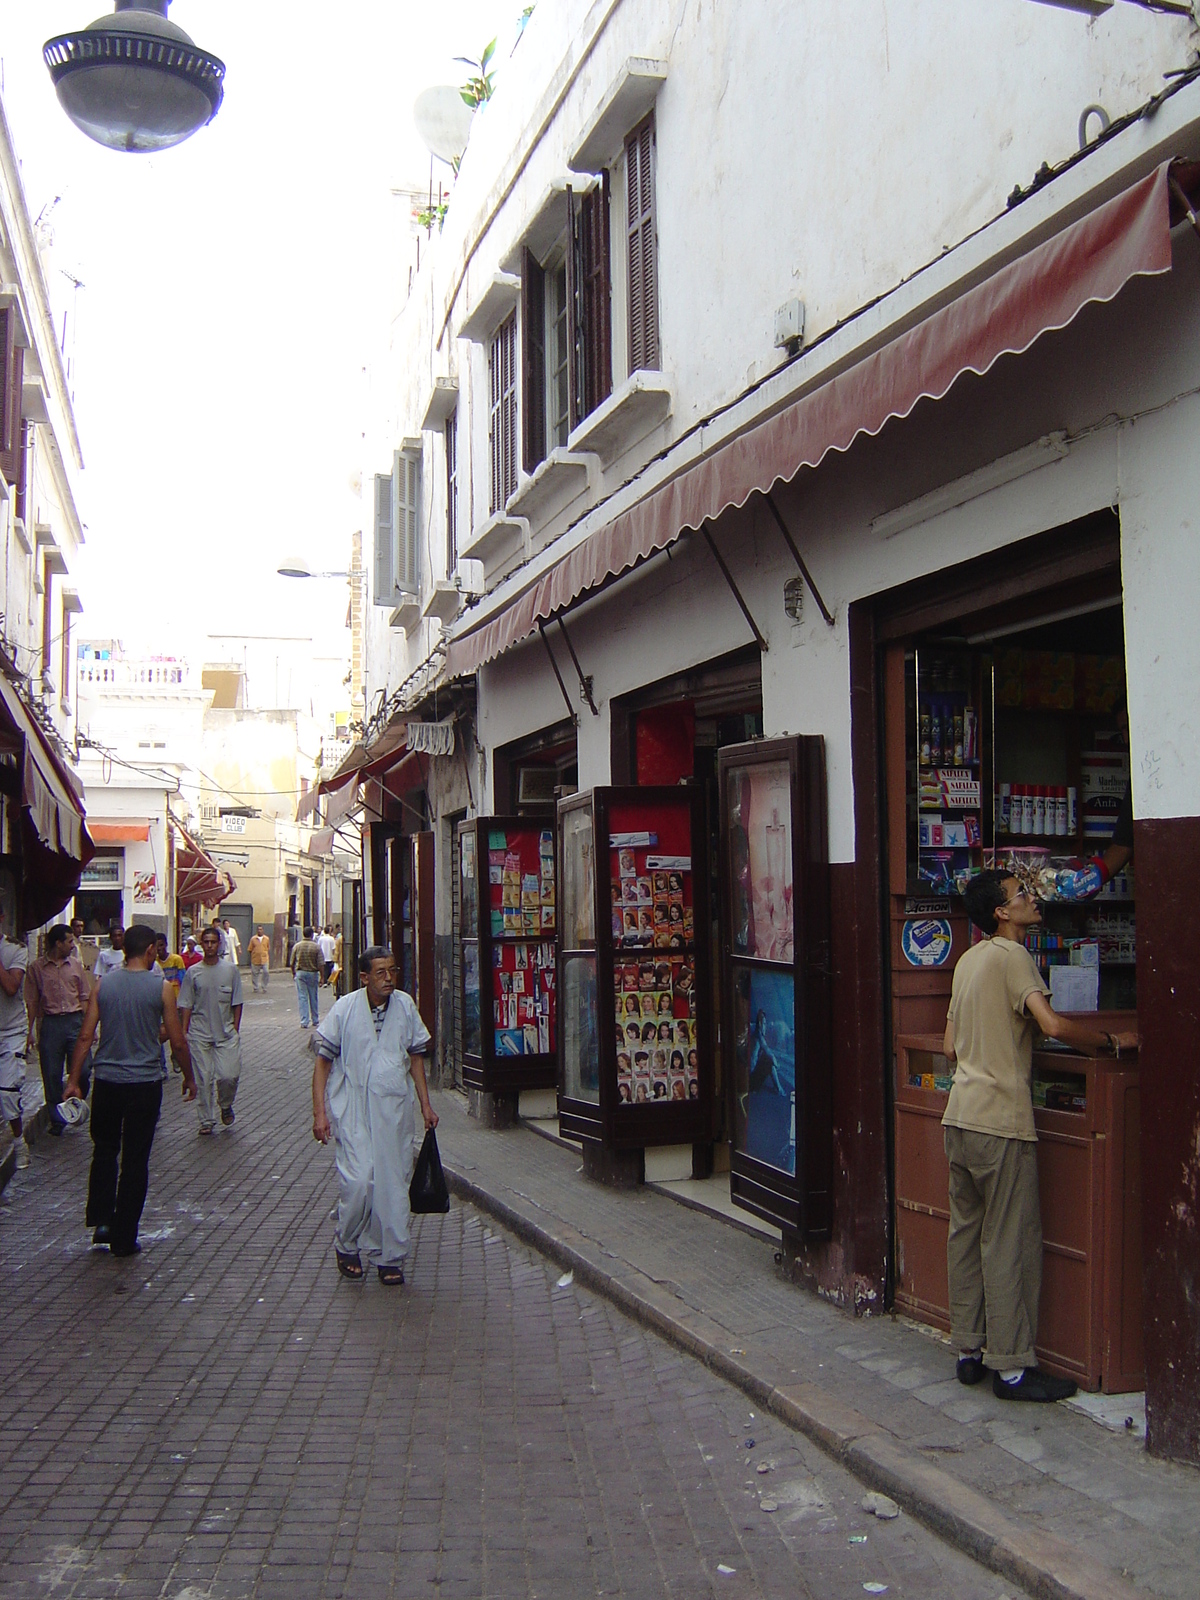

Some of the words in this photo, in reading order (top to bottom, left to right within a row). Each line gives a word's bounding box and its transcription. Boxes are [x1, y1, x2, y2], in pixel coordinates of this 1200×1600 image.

[1093, 797, 1117, 808] Anfa
[225, 817, 245, 825] VIDEO
[226, 824, 243, 832] CLUB
[905, 901, 949, 914] ACTION
